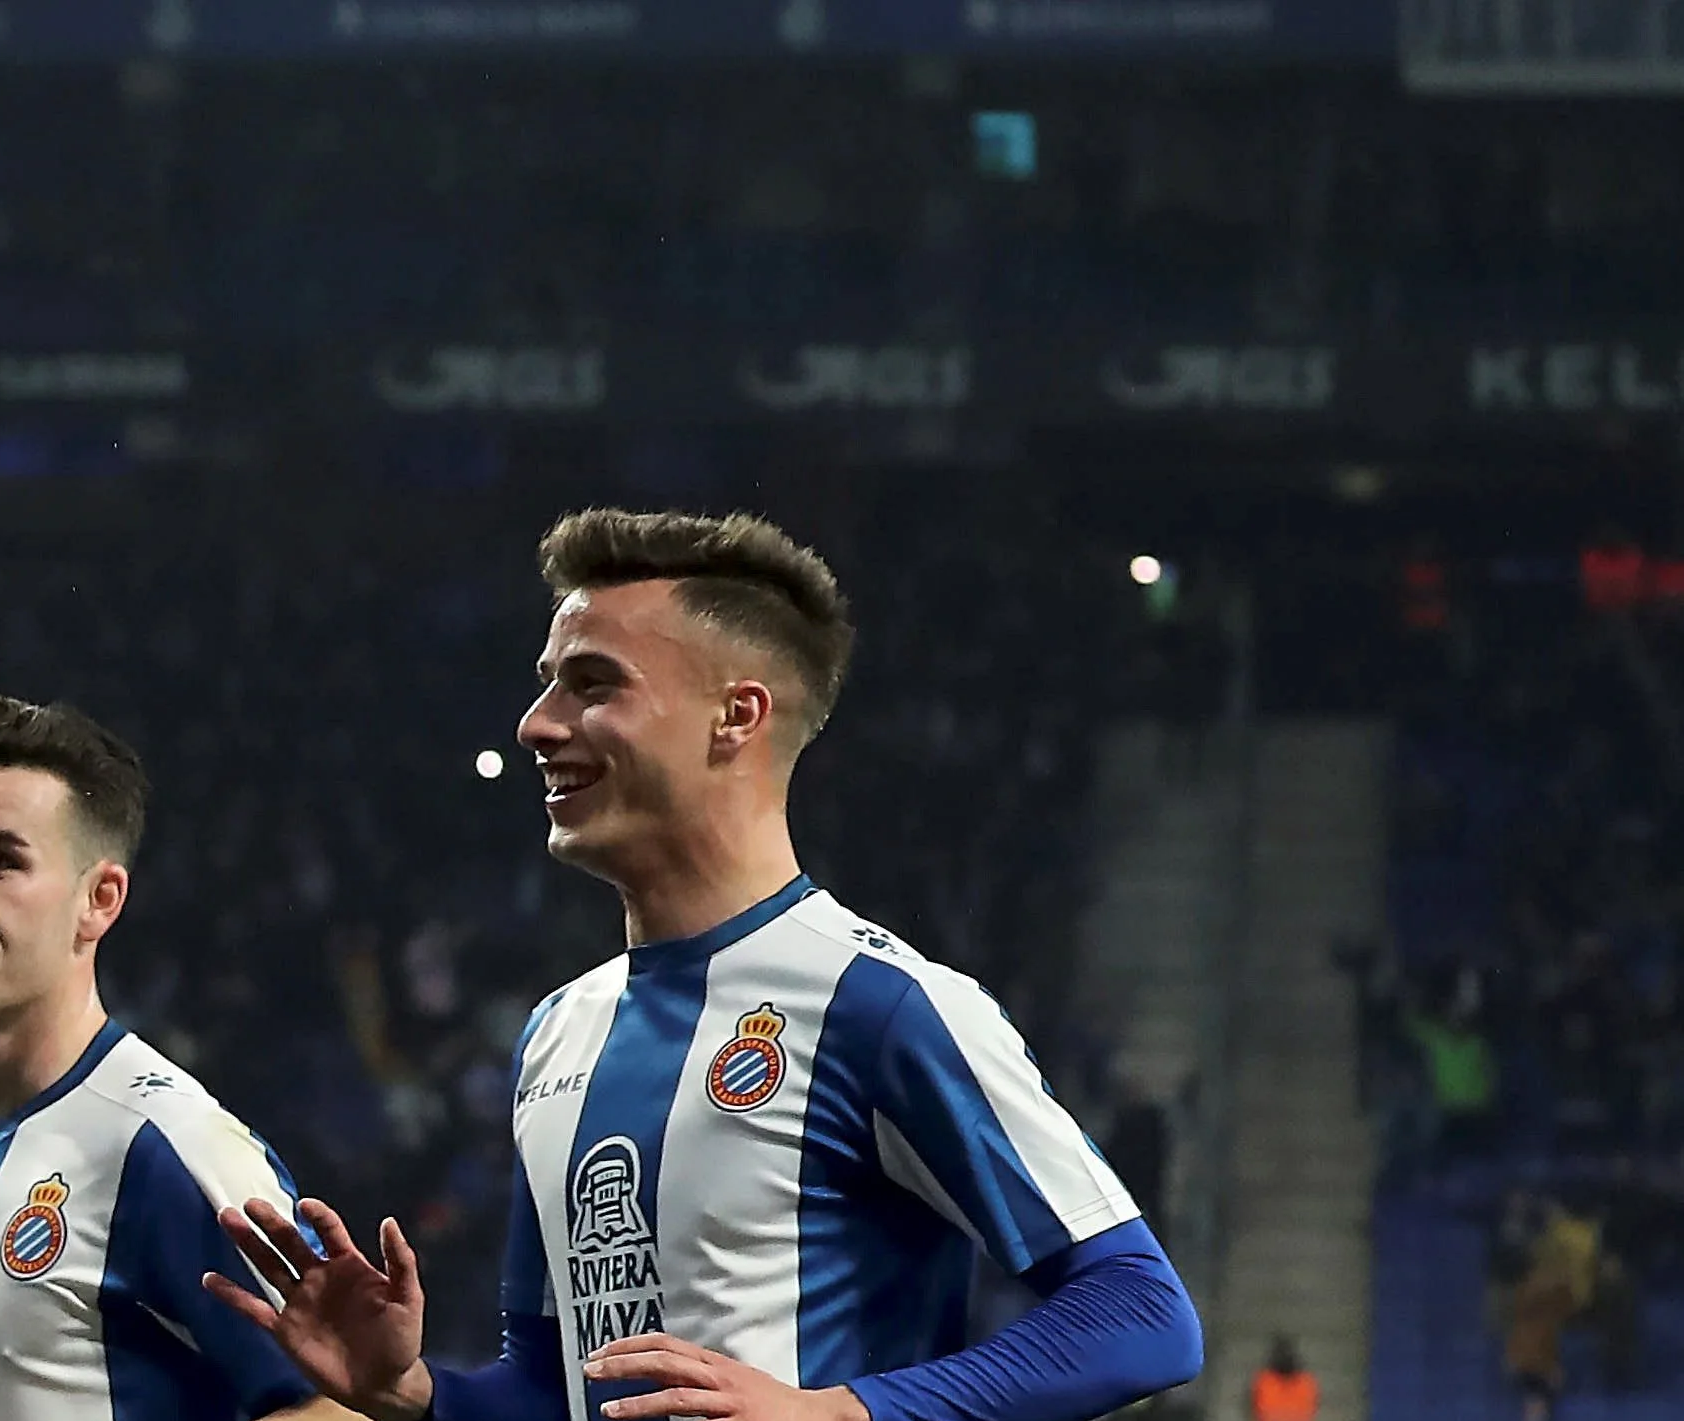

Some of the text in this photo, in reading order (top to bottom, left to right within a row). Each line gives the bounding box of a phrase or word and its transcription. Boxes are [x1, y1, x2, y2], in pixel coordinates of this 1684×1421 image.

[1469, 345, 1684, 410] KEL
[568, 1251, 661, 1299] RIVIERA
[573, 1294, 666, 1360] MAYA
